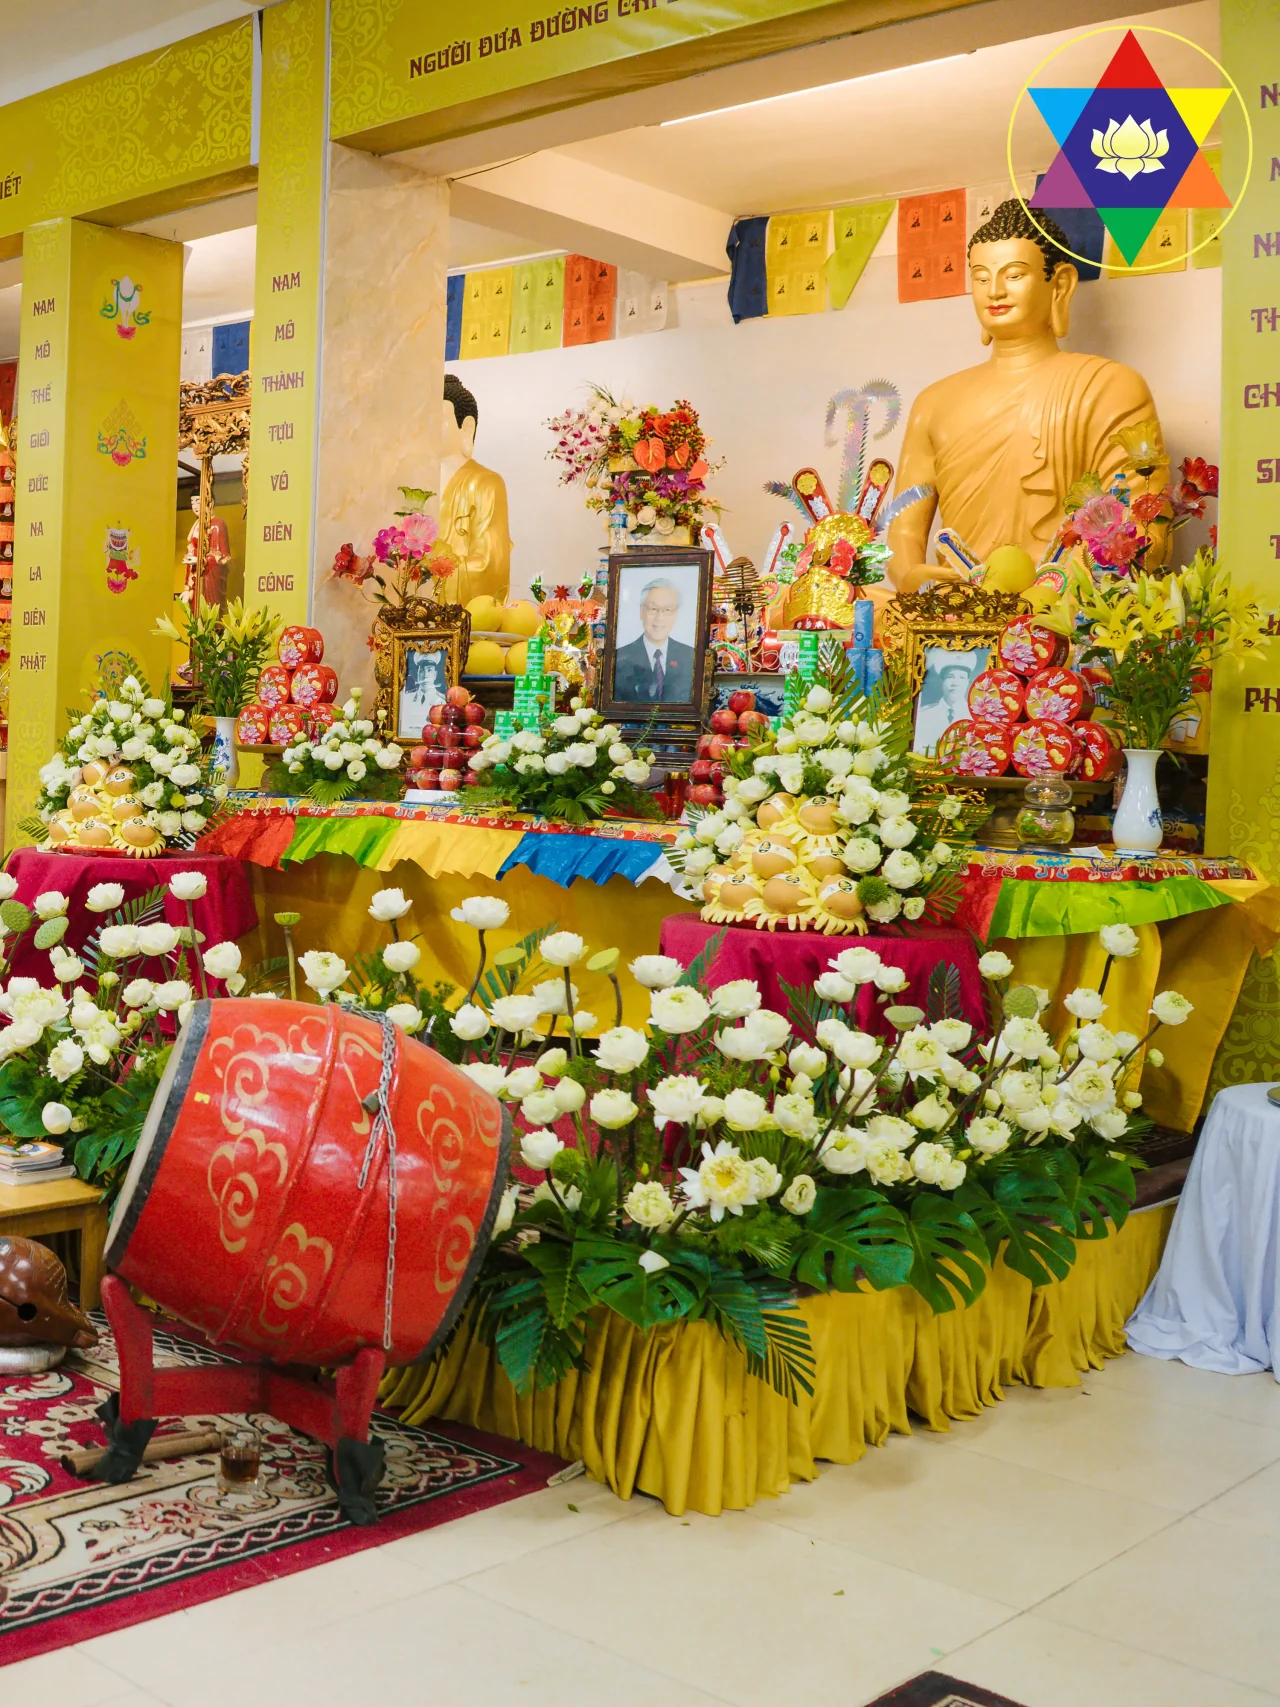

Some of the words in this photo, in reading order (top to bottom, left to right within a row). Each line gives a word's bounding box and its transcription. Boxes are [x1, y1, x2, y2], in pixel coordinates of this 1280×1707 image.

[409, 39, 471, 79] NGƯỜI
[478, 26, 522, 58] ĐƯA
[530, 1, 609, 43] ĐƯỜNG
[272, 271, 301, 293] NAM
[33, 297, 55, 317] NAM
[274, 319, 295, 342] MÔ
[34, 340, 51, 360] MÔ
[261, 370, 305, 393] THÀNH
[31, 381, 53, 405] THẾ
[30, 428, 50, 449] GIỚI
[268, 421, 294, 445] TỰU
[27, 473, 49, 493] ĐỨC
[270, 470, 289, 492] VÔ
[30, 521, 44, 537] NA
[263, 520, 293, 542] BIÊN
[29, 565, 42, 581] LA
[257, 571, 295, 593] CÔNG
[23, 607, 46, 626] DIÊN
[19, 651, 47, 674] PHẬT
[1243, 687, 1280, 713] PH
